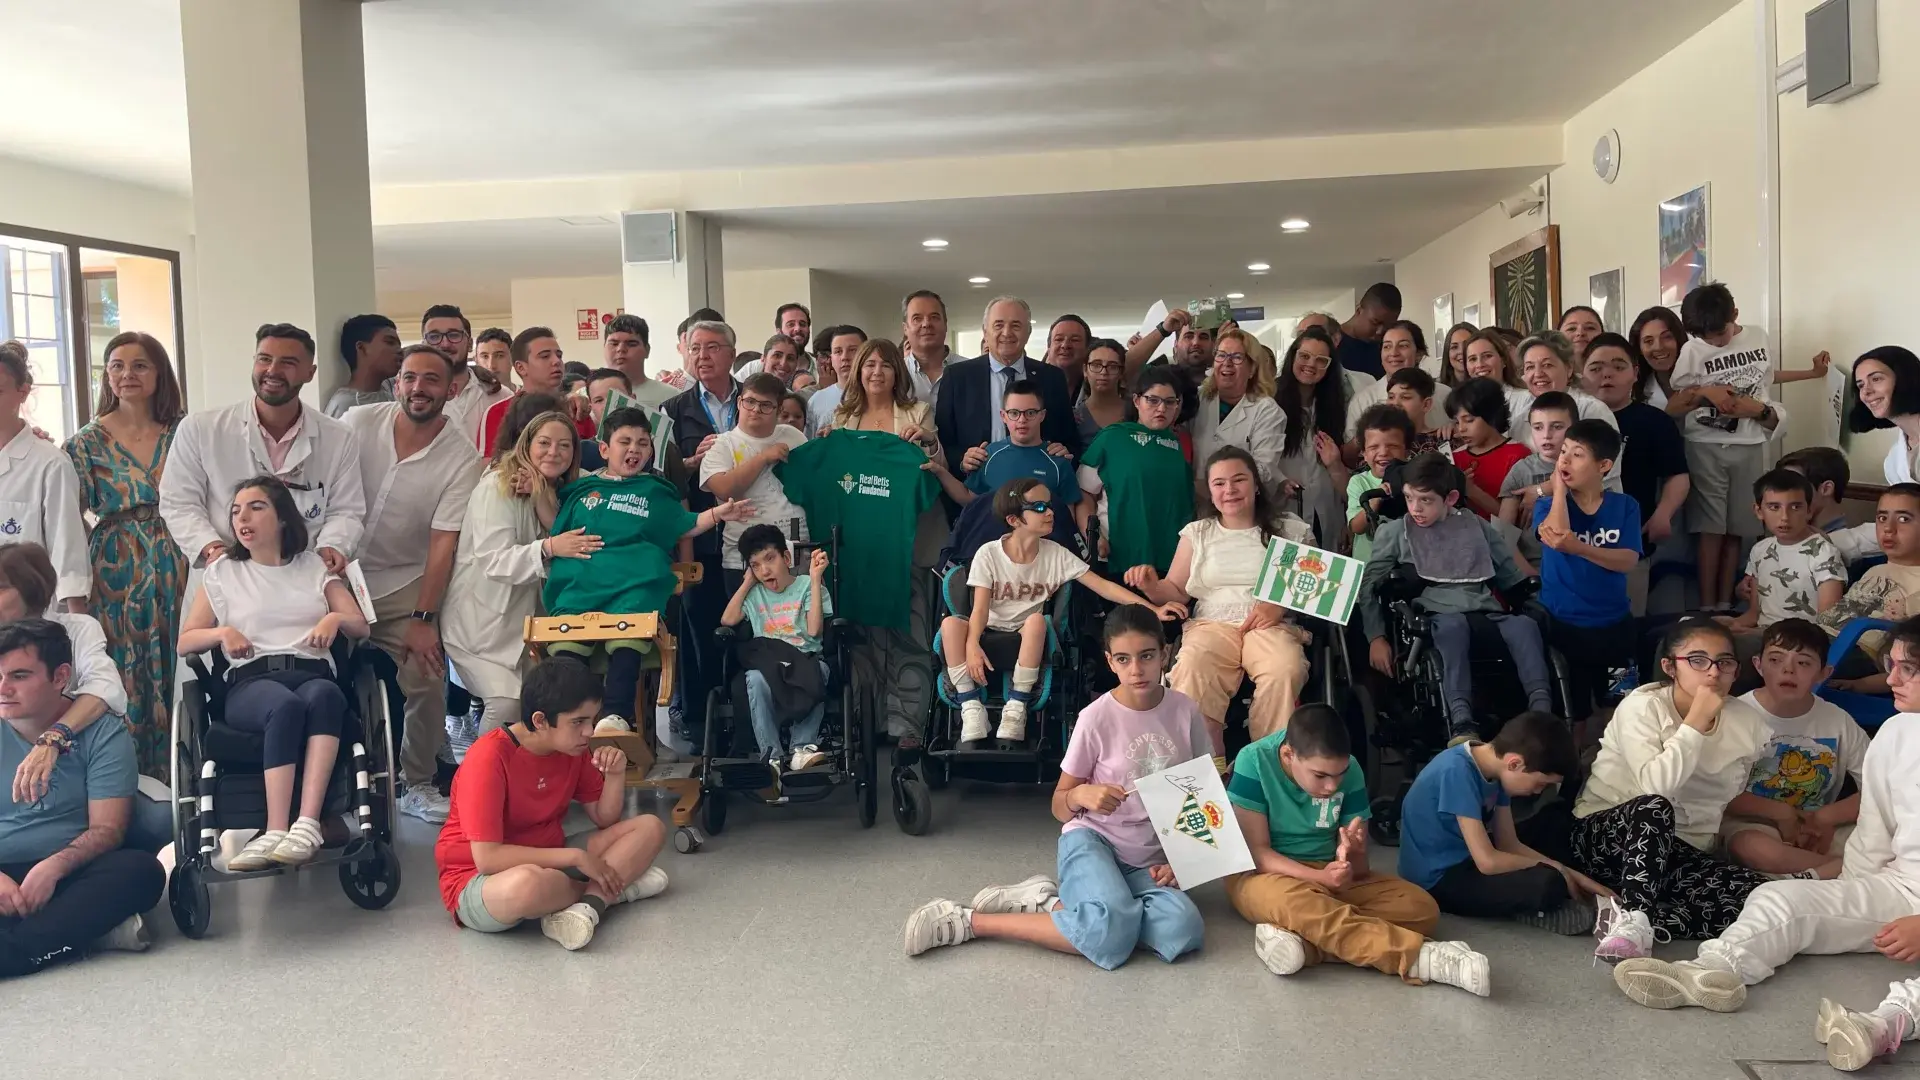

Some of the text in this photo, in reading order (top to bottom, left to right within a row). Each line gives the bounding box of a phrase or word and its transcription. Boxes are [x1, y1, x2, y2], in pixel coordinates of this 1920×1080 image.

[1704, 348, 1767, 375] RAMONES
[860, 473, 890, 487] Real Betis
[858, 484, 890, 498] Fundación
[610, 493, 649, 508] Real Betis
[607, 501, 650, 518] Fundación
[990, 580, 1059, 602] HAPPY
[582, 613, 602, 622] CAT
[1125, 733, 1178, 760] CONVERSE
